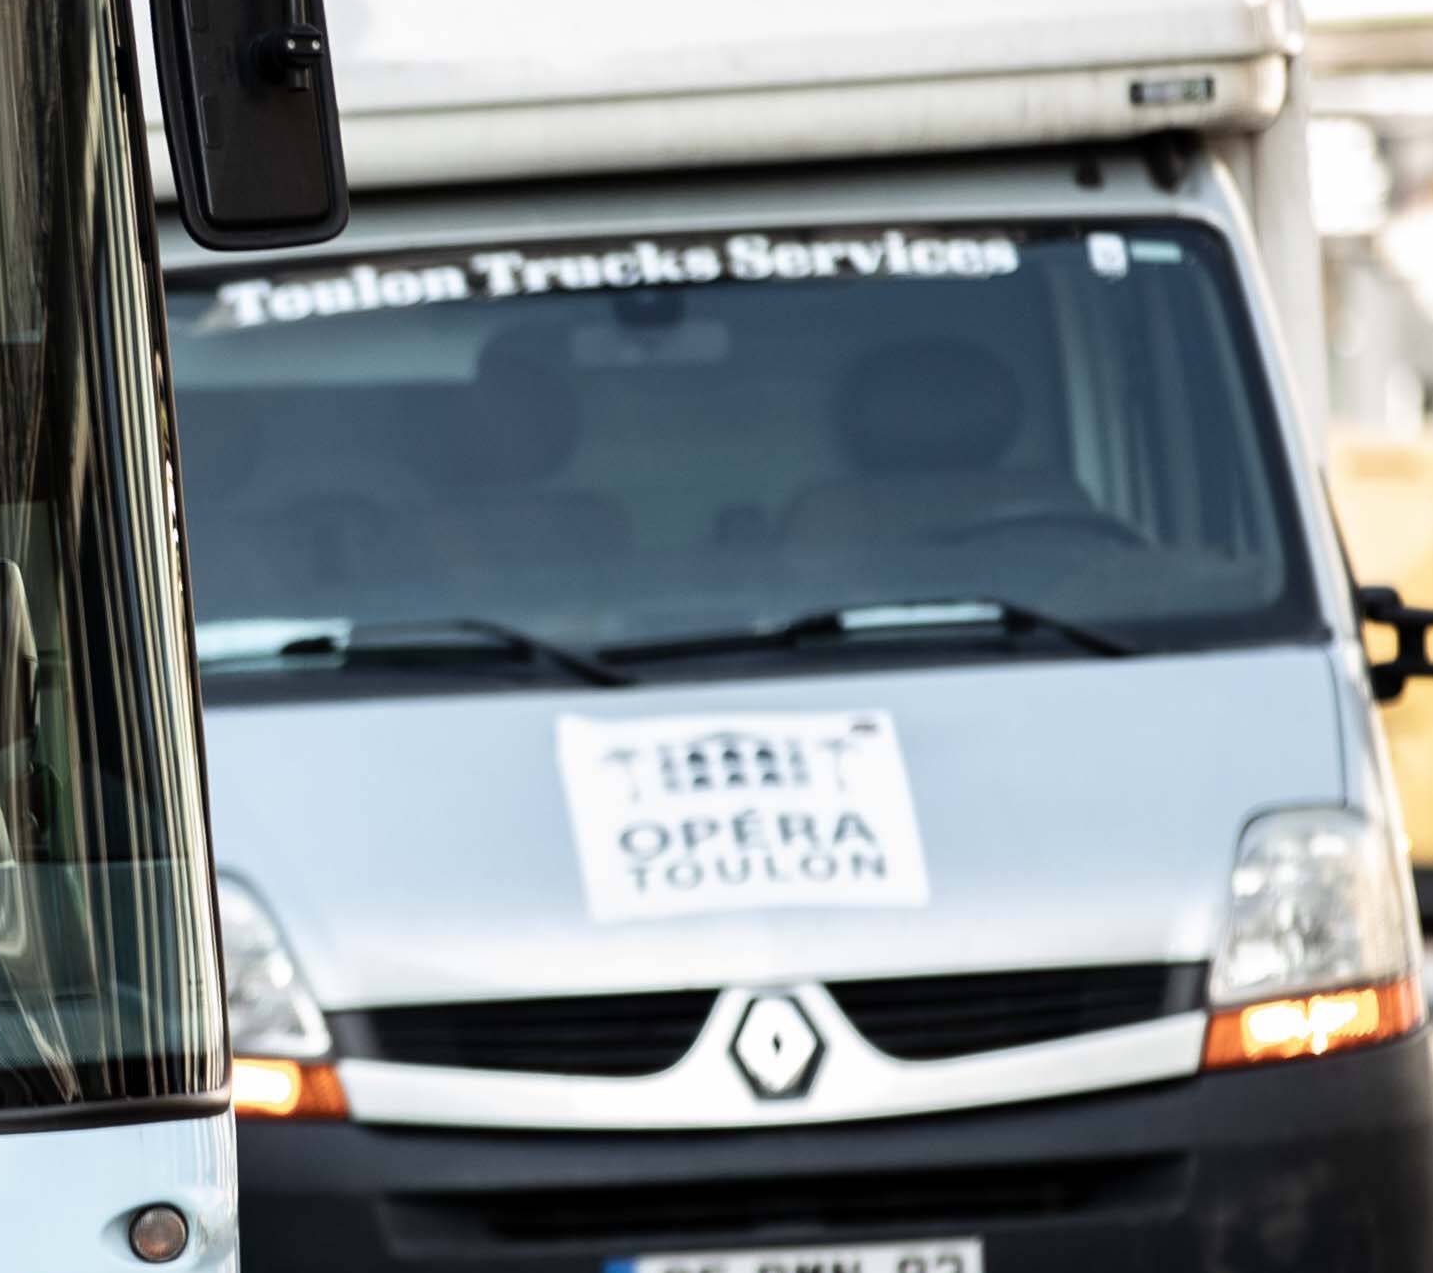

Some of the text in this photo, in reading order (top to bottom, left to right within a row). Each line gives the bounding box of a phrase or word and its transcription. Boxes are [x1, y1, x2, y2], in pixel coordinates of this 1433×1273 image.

[216, 231, 1019, 327] Toulon Trucks Services
[618, 808, 878, 860] OPÉRA
[628, 853, 888, 893] TOULON
